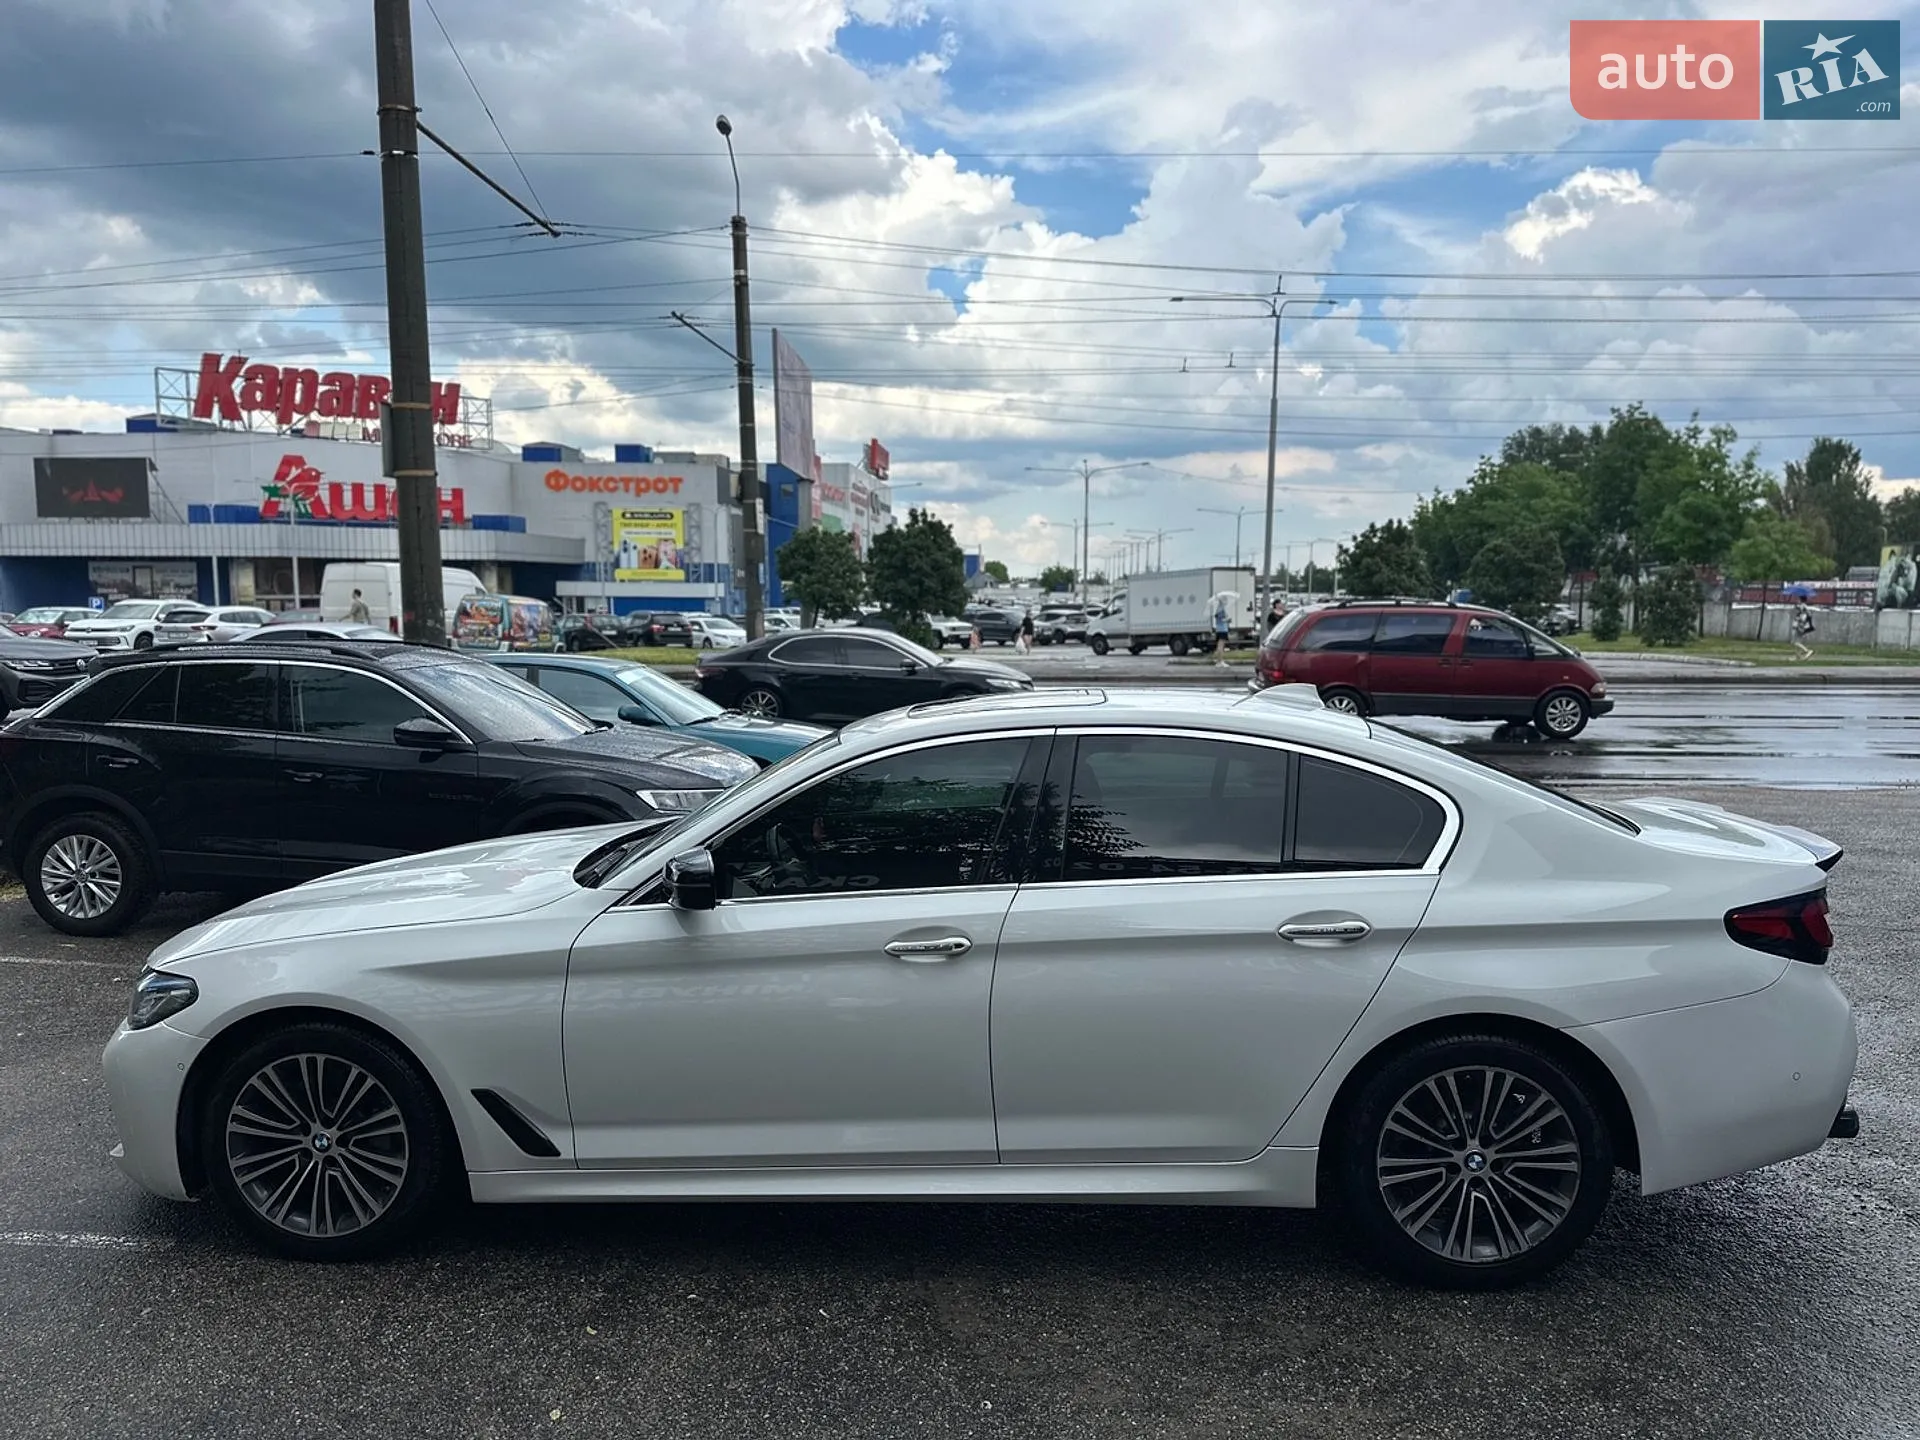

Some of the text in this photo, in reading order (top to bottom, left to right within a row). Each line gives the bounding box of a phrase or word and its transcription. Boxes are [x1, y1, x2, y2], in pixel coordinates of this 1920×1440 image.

[193, 352, 461, 425] Каравн
[260, 454, 465, 526] Ашн
[544, 468, 684, 498] Фокстрот
